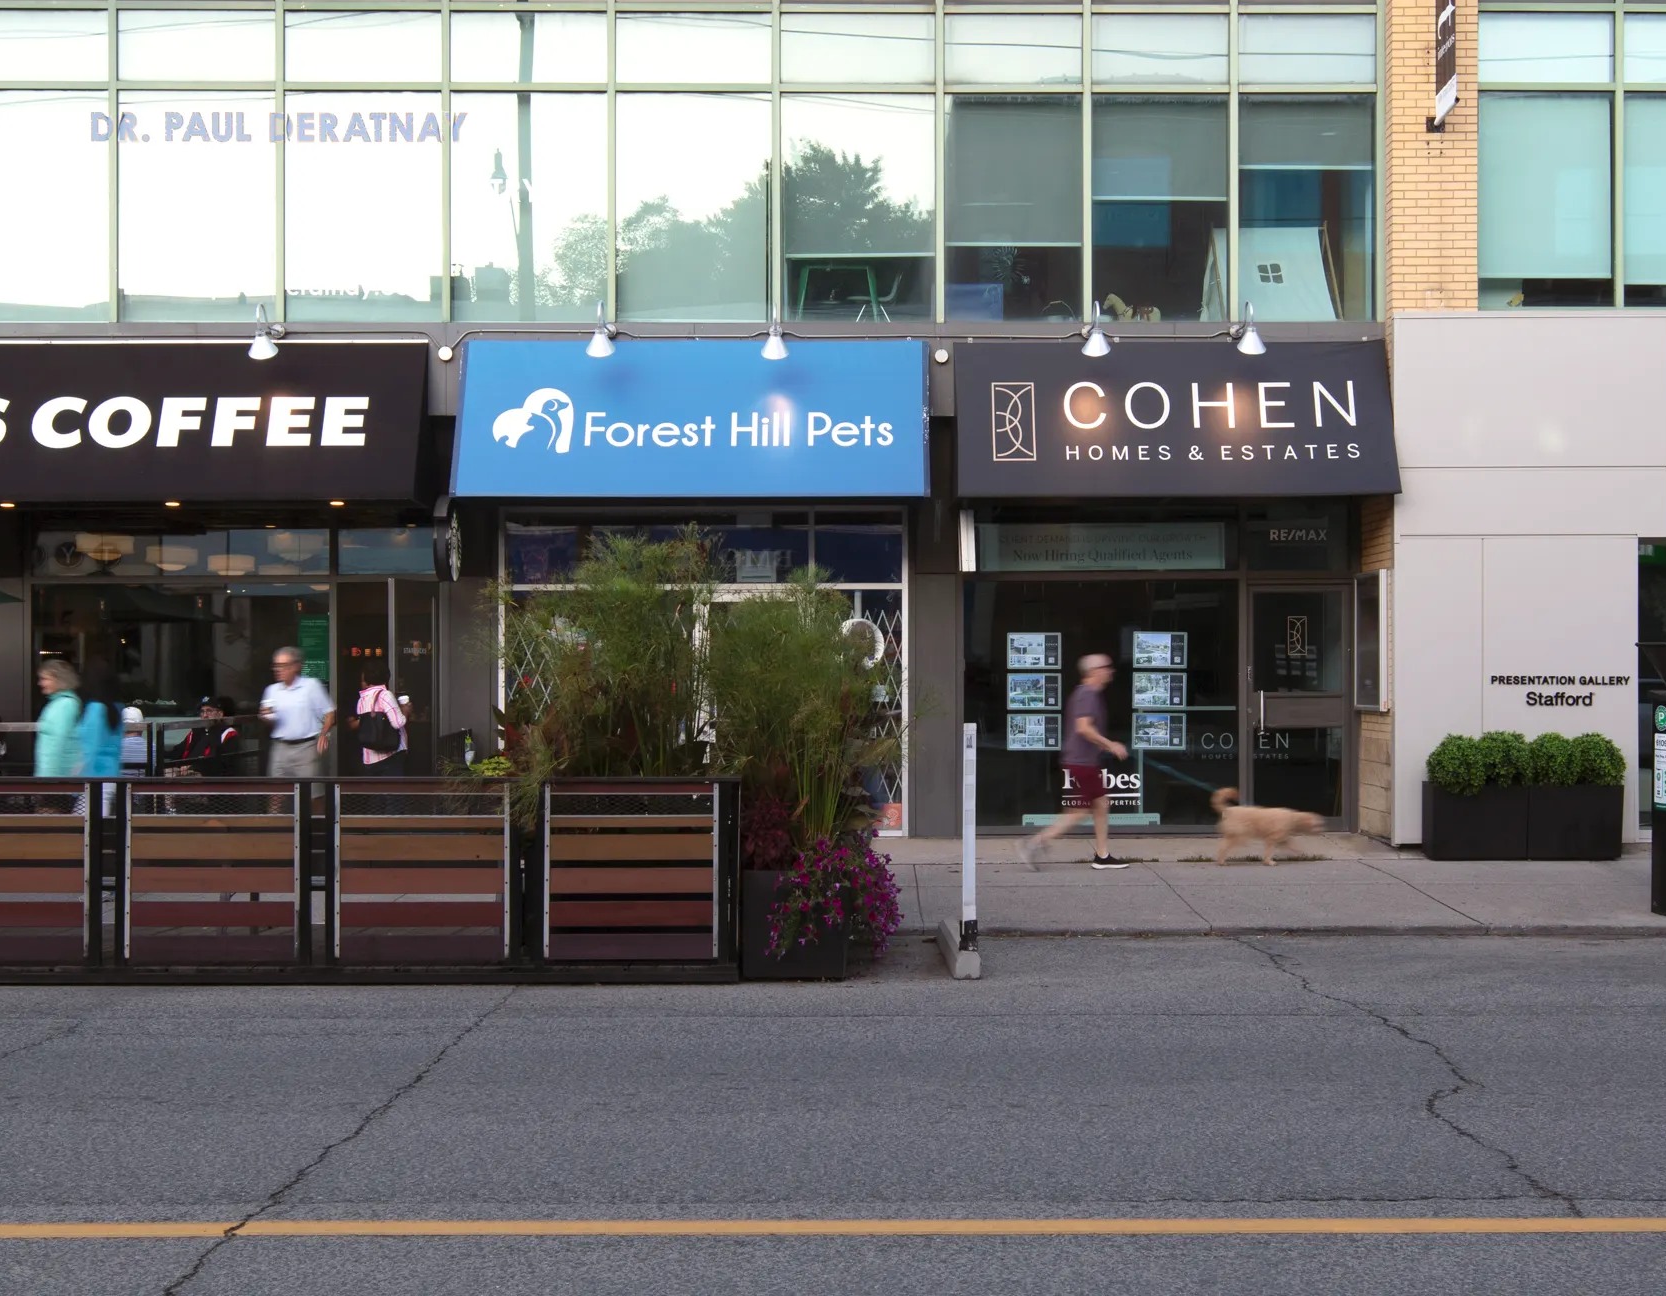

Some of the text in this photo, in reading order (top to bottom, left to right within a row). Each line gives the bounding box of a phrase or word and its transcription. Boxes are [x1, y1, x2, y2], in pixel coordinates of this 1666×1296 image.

[90, 112, 468, 144] DR. PAUL DERATNAY
[1064, 381, 1356, 429] COHEN
[31, 396, 370, 449] COFFEE
[584, 411, 894, 447] Forest Hill Pets
[1066, 444, 1360, 461] HOMES & ESTATES
[999, 534, 1034, 544] CLIENT
[1138, 533, 1160, 544] OUR
[1163, 533, 1207, 543] GROWTH
[1269, 529, 1327, 541] RE/MAX
[1013, 548, 1193, 564] Now Hiring Qualified Agents
[1491, 675, 1630, 686] PRESENTATION GALLERY
[1526, 691, 1593, 707] Stafford
[1201, 732, 1289, 750] COEN
[1062, 768, 1141, 789] Fbes
